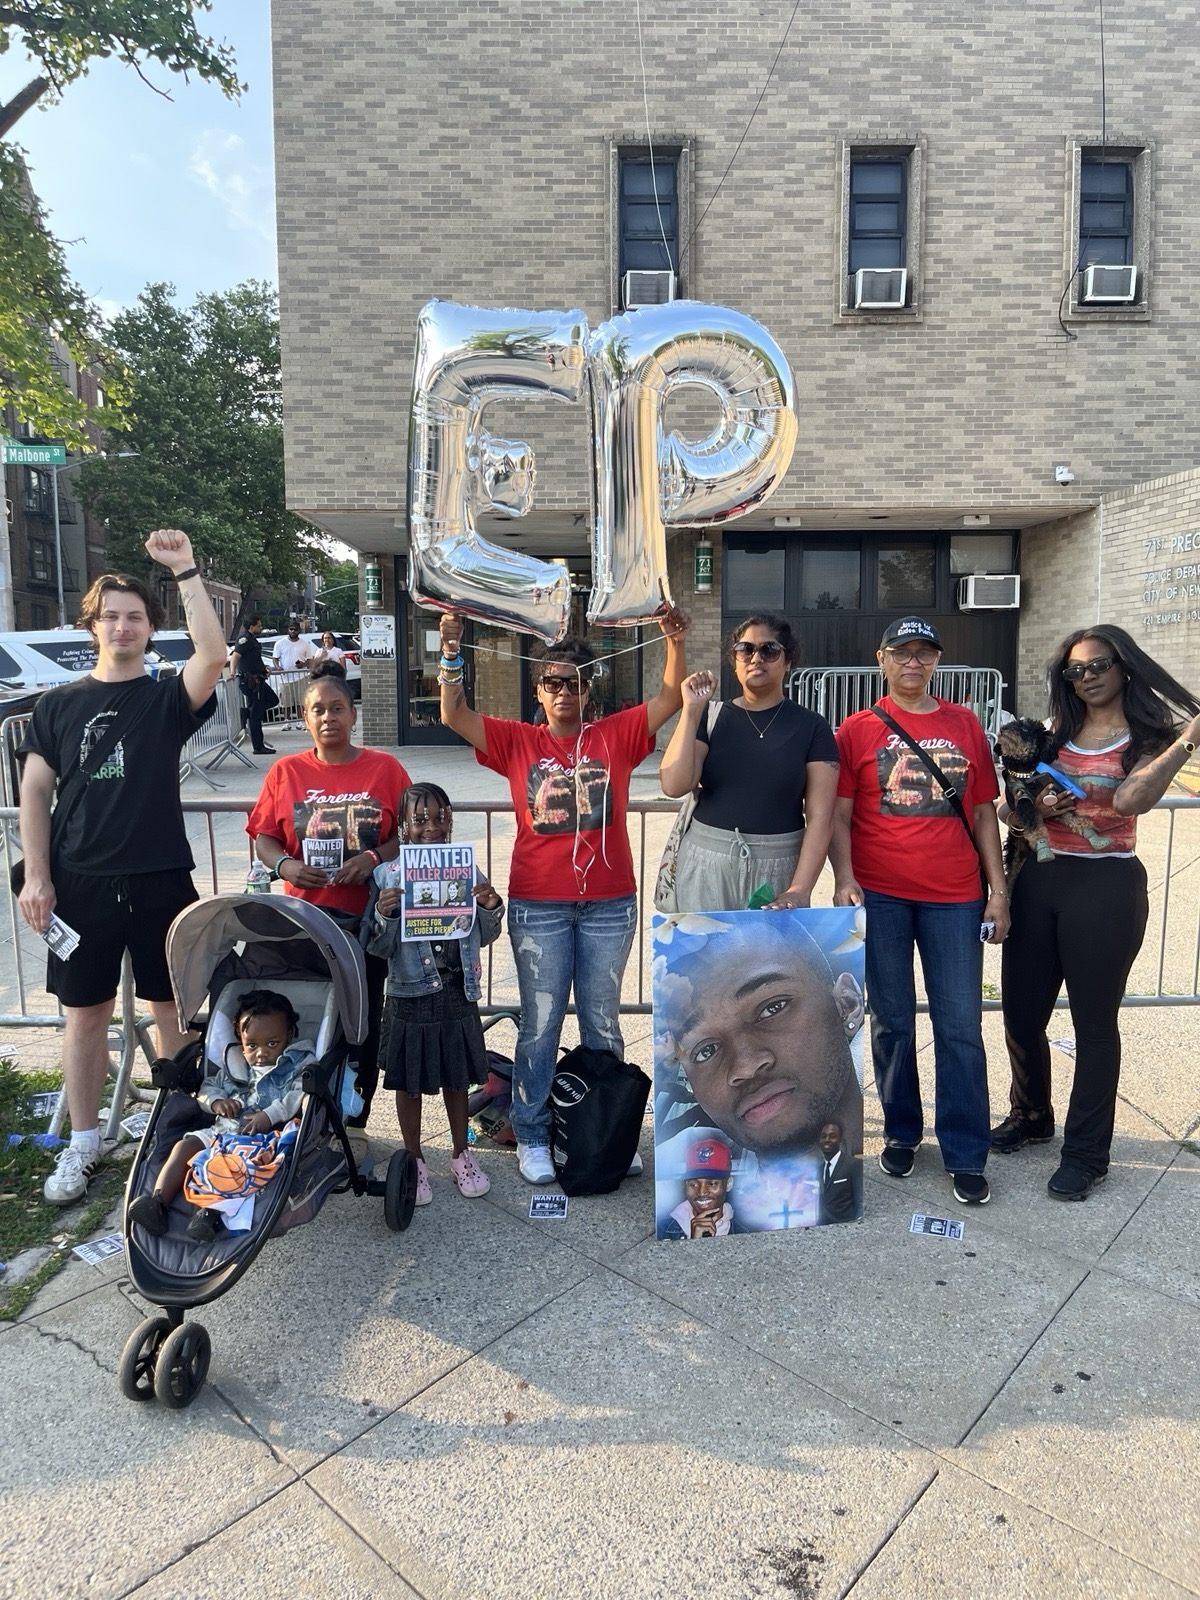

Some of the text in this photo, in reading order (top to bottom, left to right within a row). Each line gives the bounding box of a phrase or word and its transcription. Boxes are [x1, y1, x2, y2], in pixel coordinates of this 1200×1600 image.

[9, 448, 60, 462] Malbone St
[699, 558, 711, 567] 71
[368, 578, 379, 586] 71
[1143, 568, 1172, 585] POLICE
[1142, 588, 1161, 603] CITY
[1165, 586, 1178, 600] OF
[1156, 612, 1181, 625] EMPIRE
[900, 621, 922, 630] Justice
[885, 734, 956, 750] Foever
[303, 788, 371, 804] Forever
[308, 840, 341, 851] WANTED
[404, 847, 472, 869] WANTED
[406, 867, 472, 882] KILLER COPS!
[406, 918, 442, 928] JUSTICE FOR
[414, 926, 433, 935] EUDES
